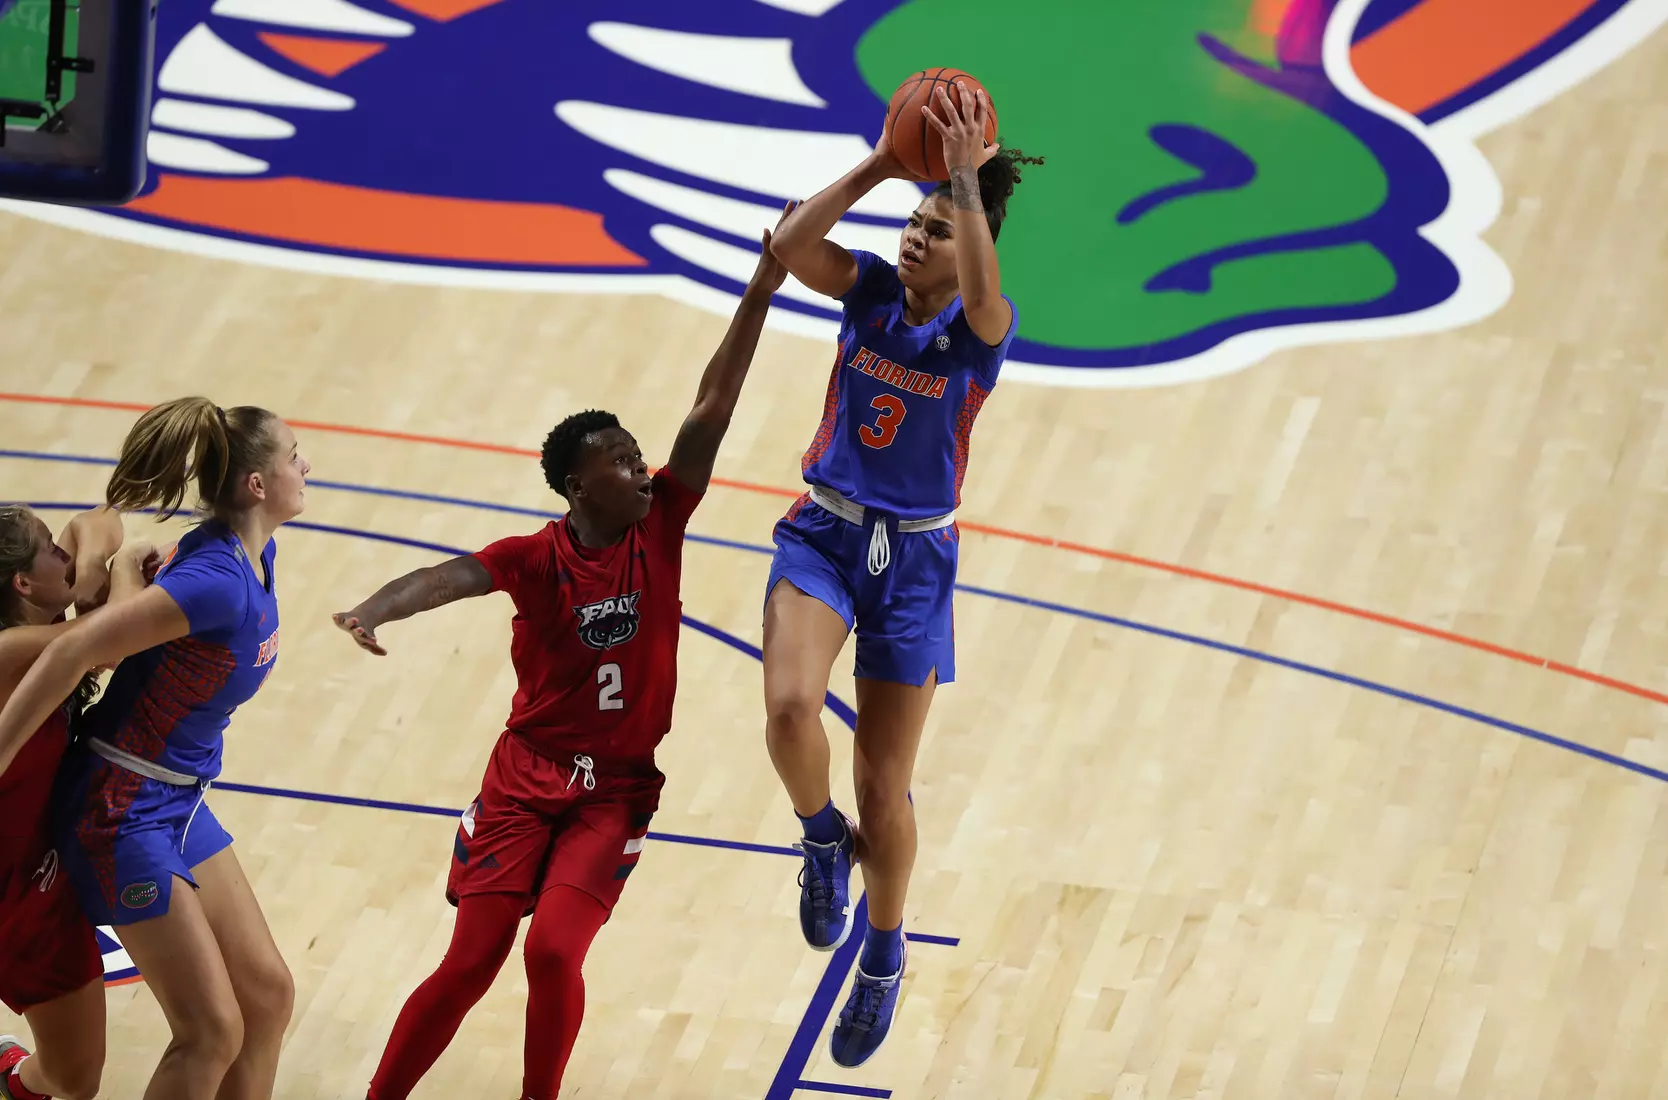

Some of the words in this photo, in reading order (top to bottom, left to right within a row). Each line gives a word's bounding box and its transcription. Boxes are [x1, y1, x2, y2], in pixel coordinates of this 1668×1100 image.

[847, 346, 948, 399] FLORIDA
[858, 393, 907, 450] 3
[581, 598, 635, 627] FAU
[597, 664, 624, 711] 2
